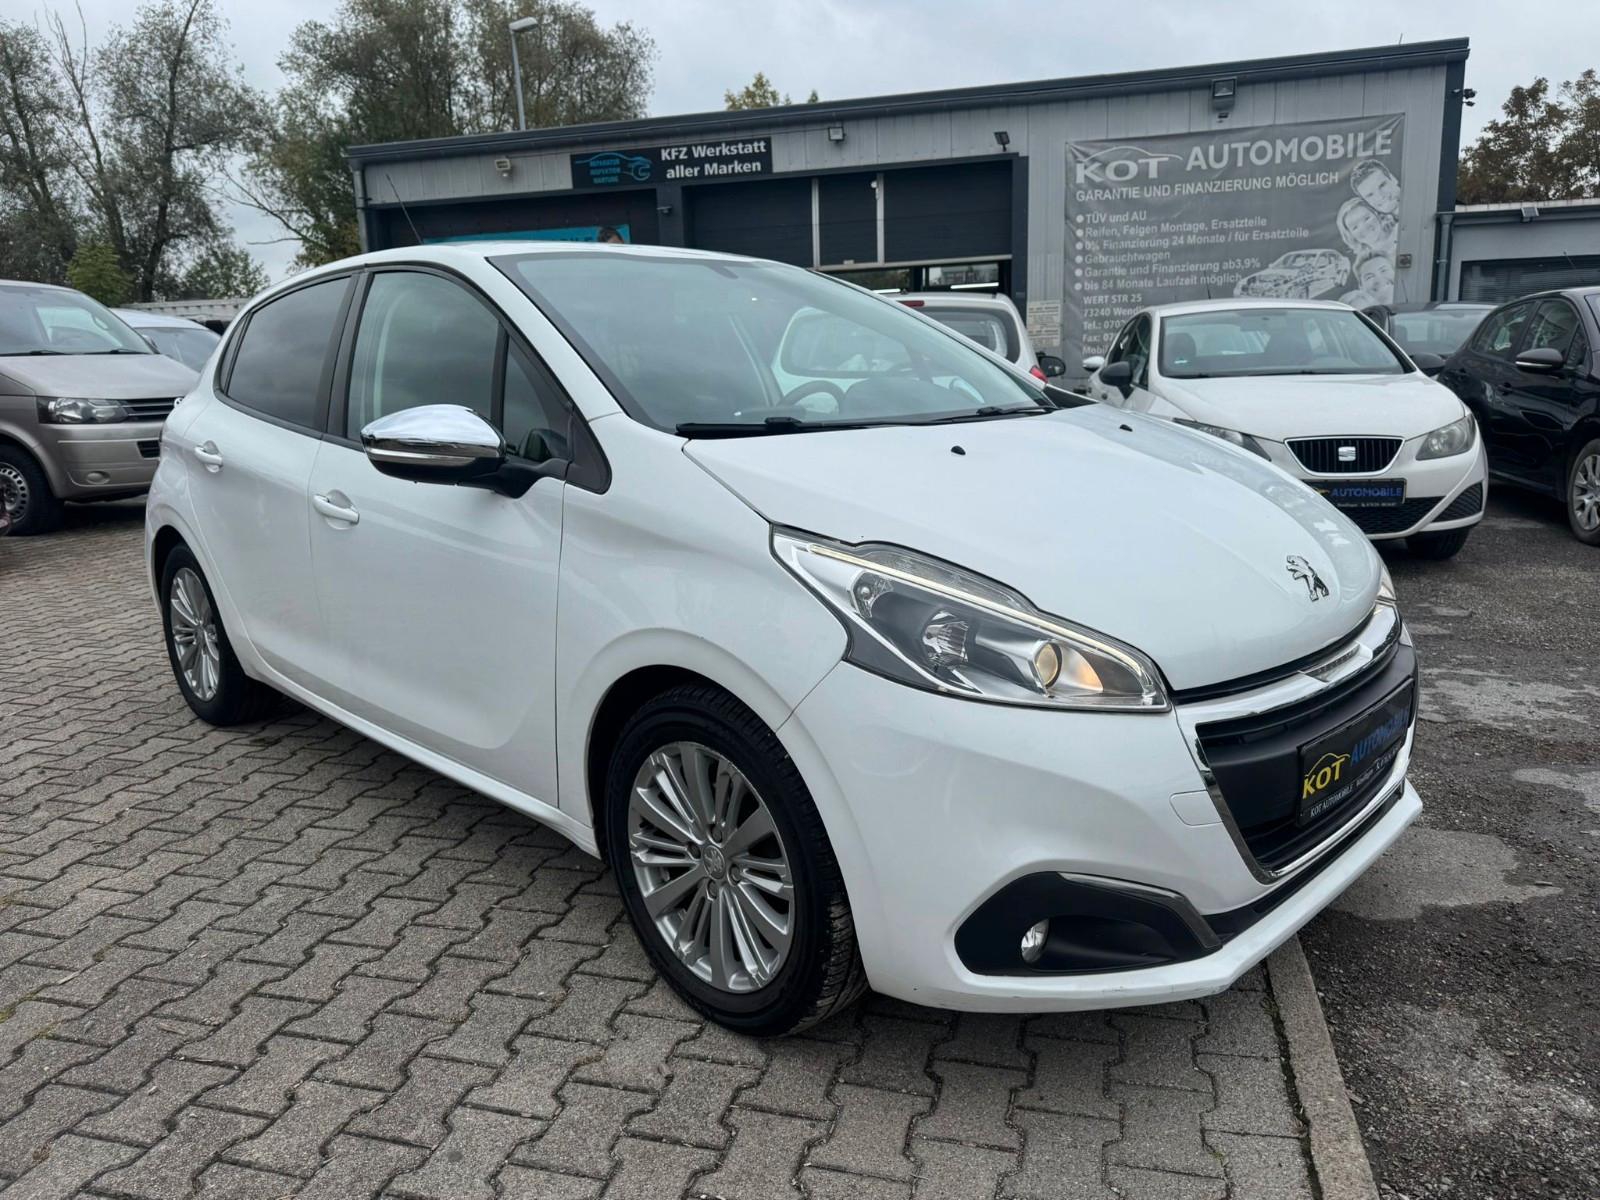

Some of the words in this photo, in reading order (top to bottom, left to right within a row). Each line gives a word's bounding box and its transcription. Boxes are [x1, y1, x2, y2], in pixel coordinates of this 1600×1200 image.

[660, 147, 688, 160] KFZ
[691, 141, 766, 158] Werkstatt
[1075, 157, 1169, 184] KOT
[1185, 128, 1393, 171] AUTOMOBILE
[666, 165, 700, 179] aller
[704, 160, 761, 176] Marken
[1076, 187, 1141, 201] GARANTIE
[1143, 184, 1170, 197] UND
[1174, 176, 1272, 195] FINANZIERUNG
[1275, 172, 1339, 188] MÖGLICH
[1085, 211, 1107, 224] TÜV
[1109, 211, 1129, 222] und
[1131, 211, 1147, 221] AU
[1085, 226, 1120, 237] Reifen,
[1123, 224, 1158, 236] Felgen
[1160, 221, 1208, 233] Montage,
[1211, 216, 1267, 229] Ersatzteile
[1103, 238, 1169, 250] Finanzierung
[1171, 235, 1184, 246] 24
[1186, 233, 1225, 244] Monate
[1234, 231, 1250, 242] für
[1253, 227, 1309, 240] Ersatzteile
[1084, 252, 1170, 264] Gebrauchtwagen
[1084, 266, 1127, 277] Garantie
[1129, 264, 1150, 275] und
[1152, 261, 1220, 274] Finanzierung
[1083, 281, 1099, 291] bis
[1101, 279, 1114, 289] 84
[1117, 279, 1154, 288] Monate
[1156, 276, 1198, 287] Laufzeit
[1200, 272, 1242, 286] möglich
[1082, 295, 1109, 304] WERT
[1111, 294, 1129, 303] STR
[1130, 294, 1142, 303] 25
[1083, 307, 1111, 317] 73240
[1082, 334, 1100, 342] Fax:
[1331, 487, 1402, 497] AUTOMOBILE
[1302, 757, 1346, 800] KOT
